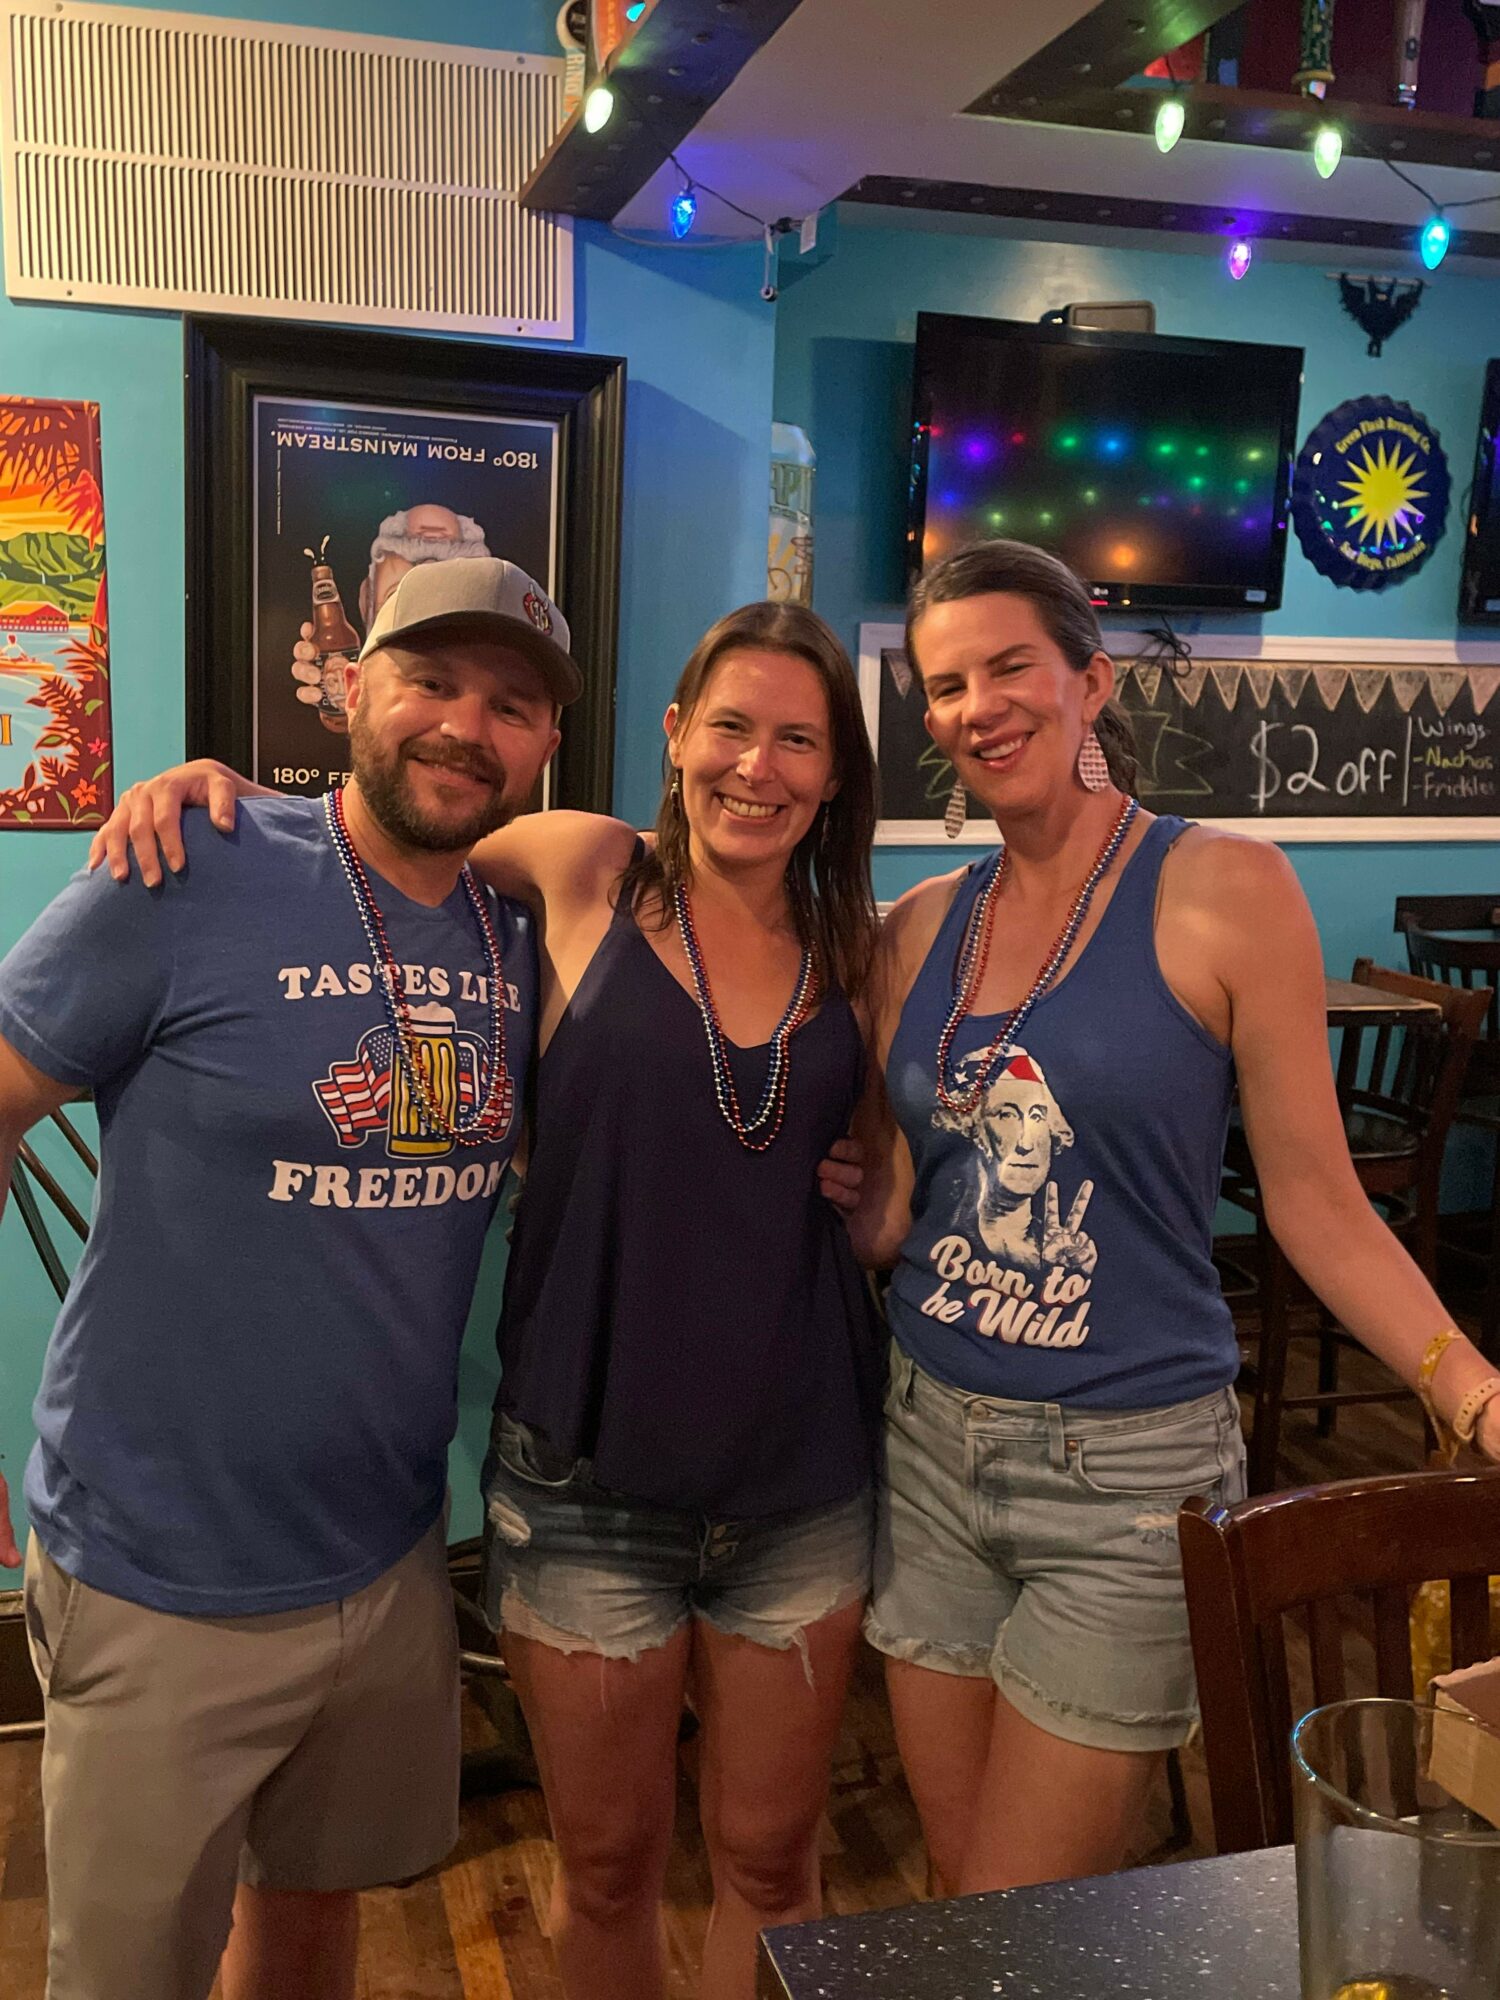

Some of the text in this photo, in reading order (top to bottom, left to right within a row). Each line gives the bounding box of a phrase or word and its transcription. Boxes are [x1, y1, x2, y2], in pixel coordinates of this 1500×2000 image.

[271, 431, 418, 457] MAINSTREAM.
[428, 444, 485, 462] FROM
[1250, 720, 1330, 812] $2
[458, 971, 521, 1013] LIE
[929, 1235, 1091, 1305] Born to
[921, 1282, 1091, 1349] be Wild
